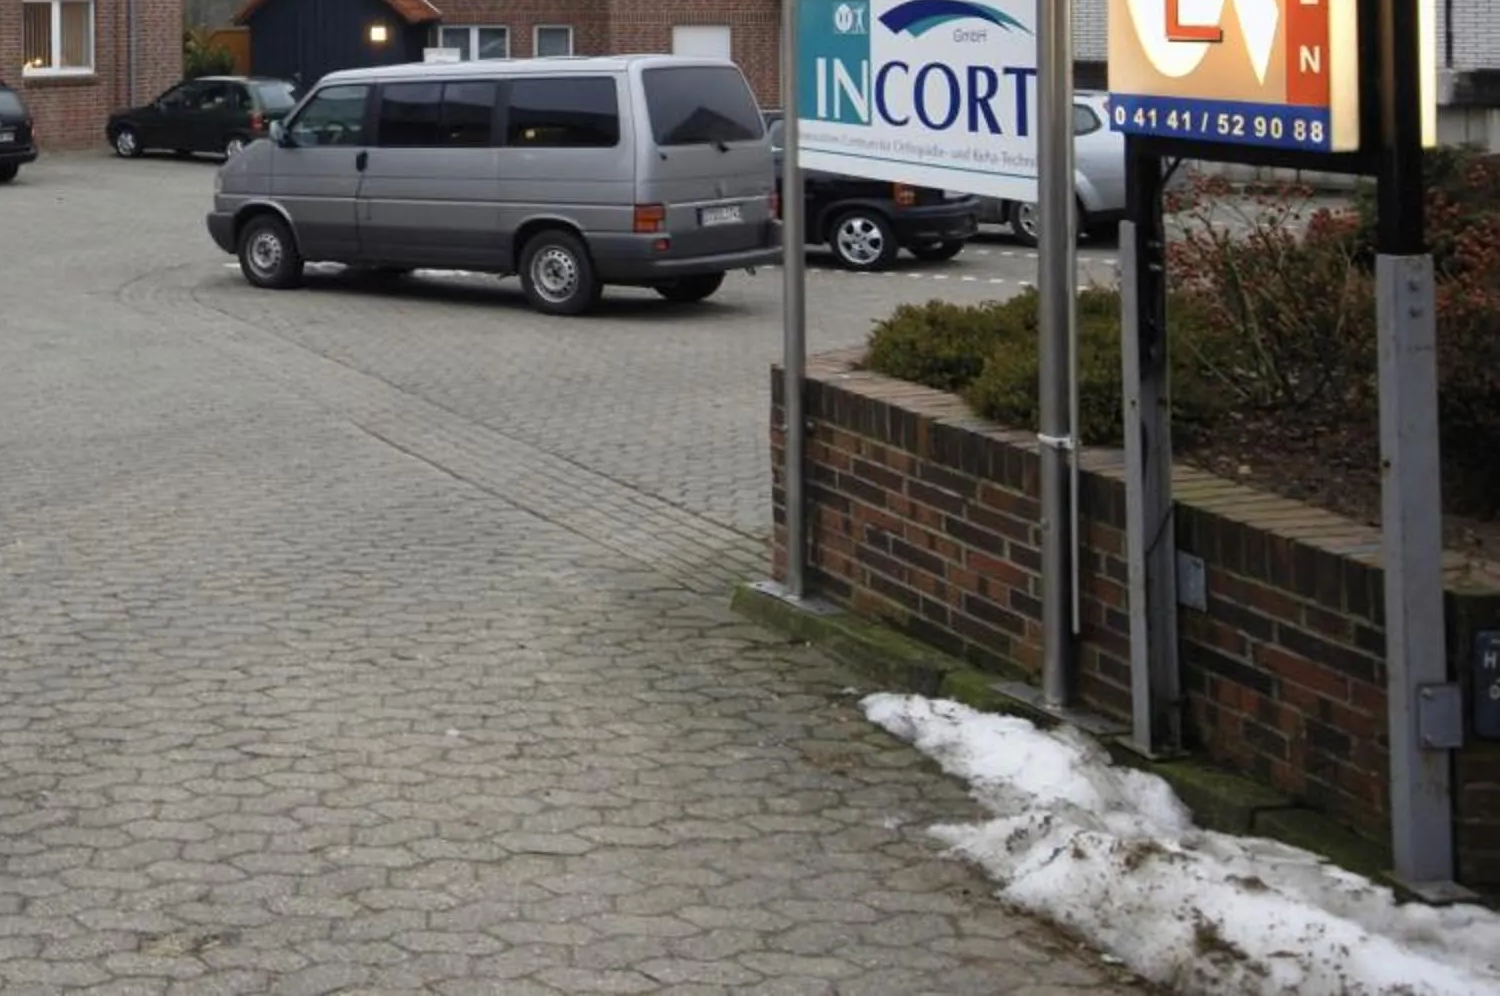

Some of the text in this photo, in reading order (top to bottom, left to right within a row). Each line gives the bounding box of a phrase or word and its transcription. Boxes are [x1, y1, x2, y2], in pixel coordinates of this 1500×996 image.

[815, 57, 1037, 137] INCORT
[1114, 106, 1126, 126] 0
[1133, 108, 1158, 129] 41
[1166, 110, 1192, 131] 41
[1216, 114, 1245, 136] 52
[1254, 117, 1284, 140] 90
[1293, 119, 1324, 143] 88
